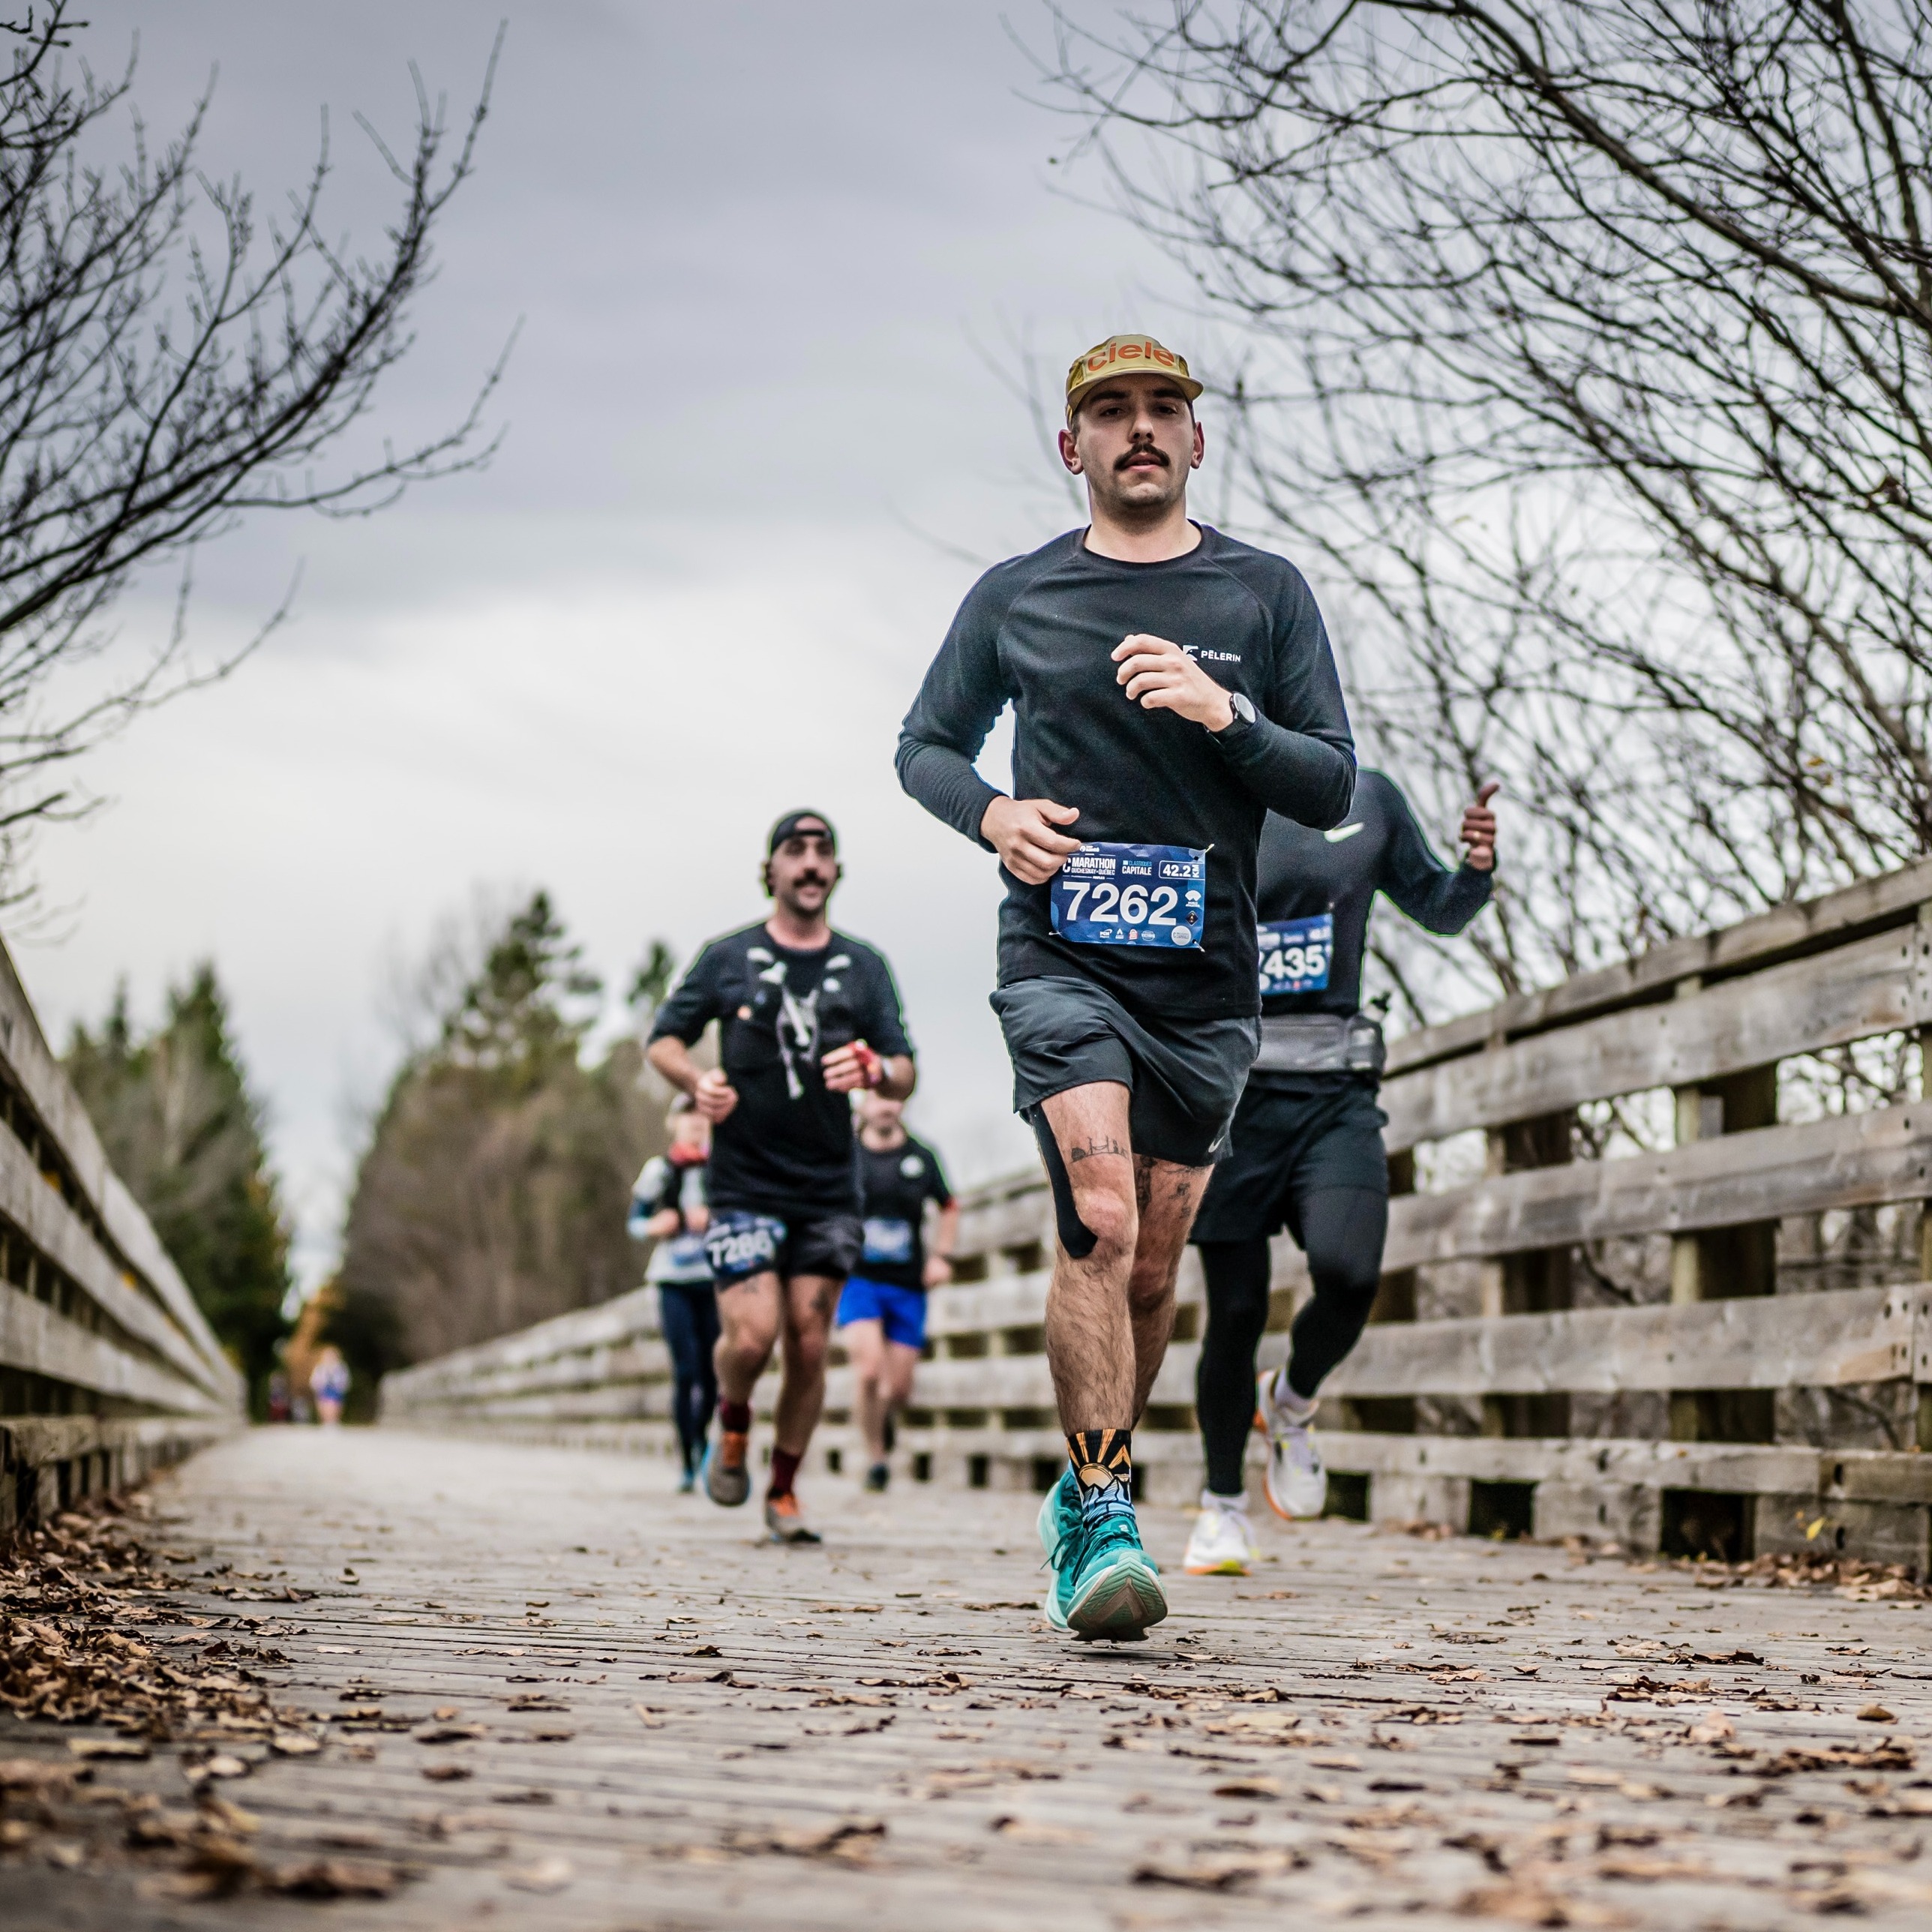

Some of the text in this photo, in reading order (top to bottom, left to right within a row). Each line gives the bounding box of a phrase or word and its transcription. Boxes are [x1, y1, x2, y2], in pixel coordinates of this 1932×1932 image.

[1088, 341, 1174, 371] ciele
[1072, 856, 1116, 869] MARATHON
[1122, 866, 1152, 875] CAPITALE
[1162, 864, 1200, 878] 42.2 KM
[1063, 881, 1178, 926] 7262
